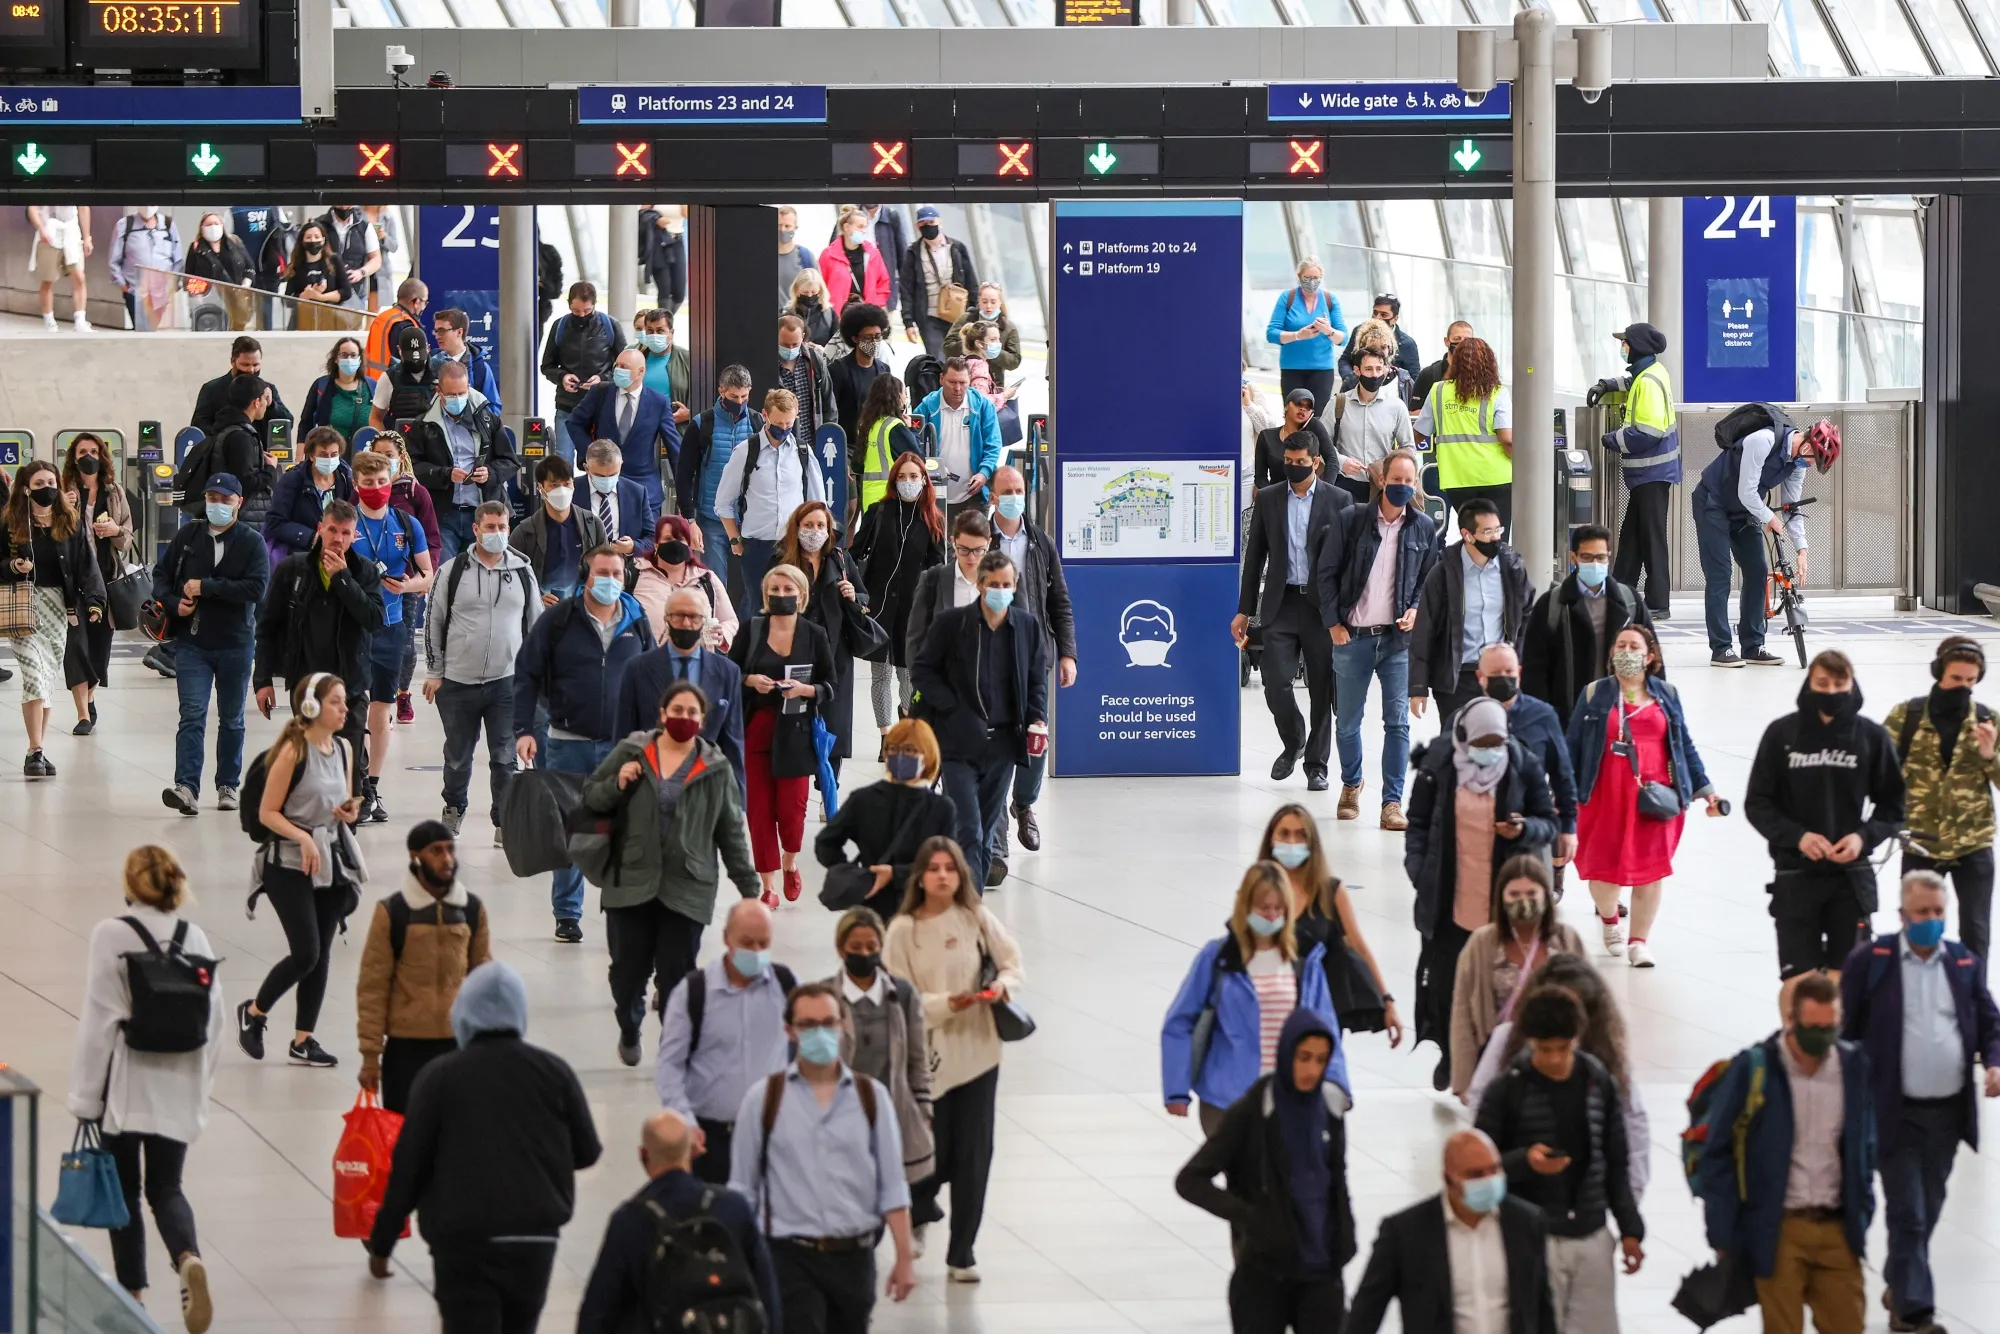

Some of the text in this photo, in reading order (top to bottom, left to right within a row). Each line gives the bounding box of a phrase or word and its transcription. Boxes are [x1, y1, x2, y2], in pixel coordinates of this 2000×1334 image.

[12, 5, 40, 17] 08:42
[103, 6, 221, 34] 08:35:11
[638, 95, 795, 111] Platforms 23 and 24
[1320, 93, 1398, 110] Wide gate
[1703, 196, 1776, 239] 24
[1097, 242, 1197, 253] Platforms 20 to 24
[1097, 263, 1160, 273] Platform 19
[1101, 694, 1195, 707] Face coverings
[1099, 711, 1196, 723] should be used
[1099, 728, 1196, 740] on our services
